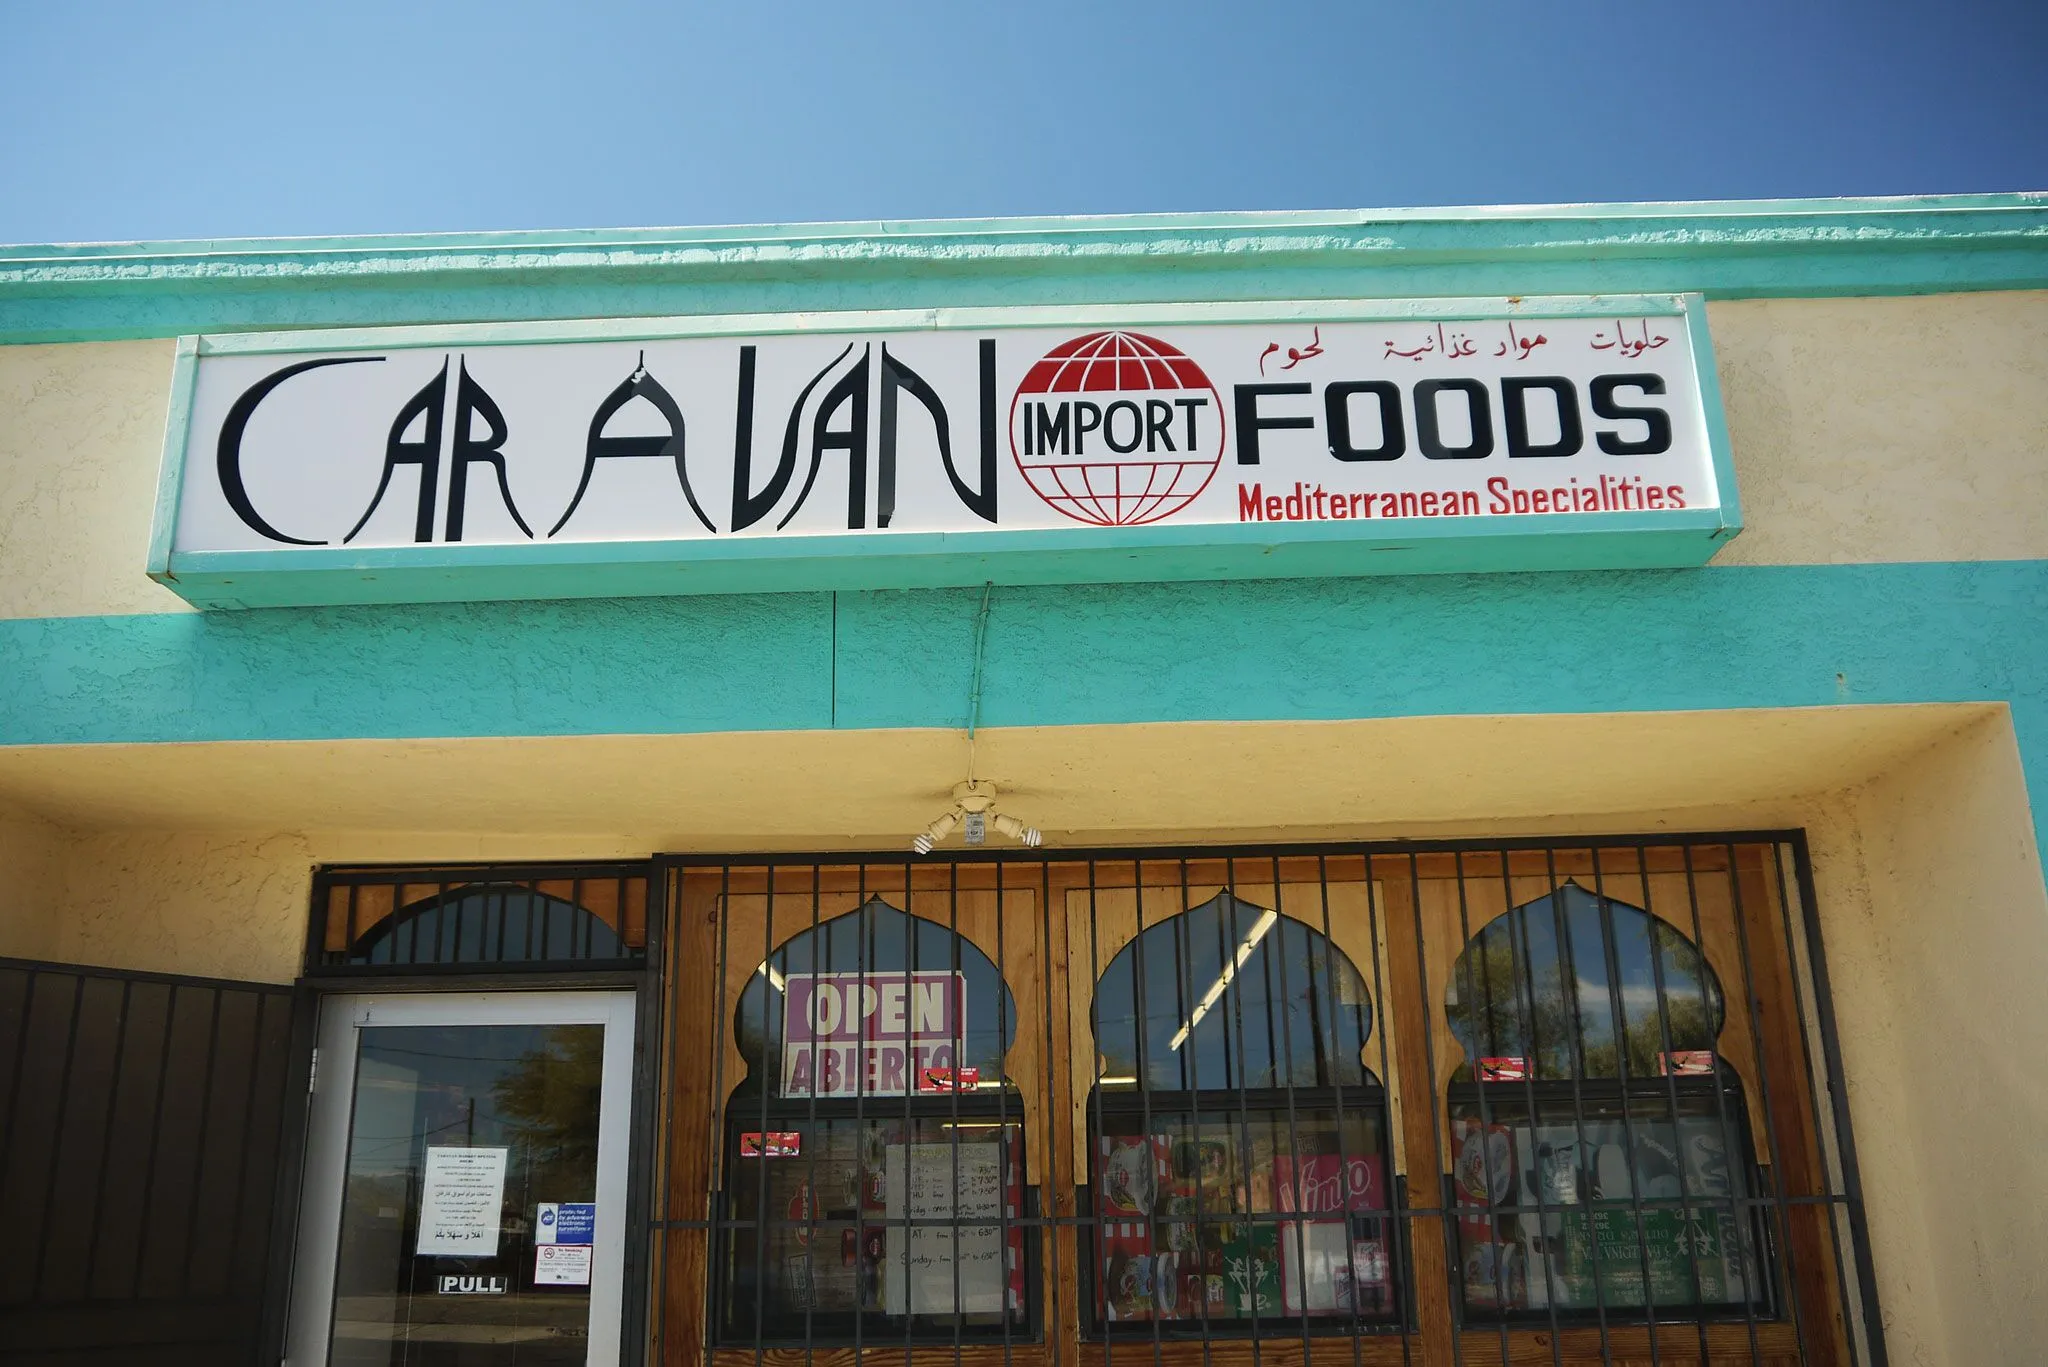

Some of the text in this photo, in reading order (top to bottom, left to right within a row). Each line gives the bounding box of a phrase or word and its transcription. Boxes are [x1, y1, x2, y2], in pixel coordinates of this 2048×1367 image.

[1259, 325, 1324, 377] لحوم
[1590, 318, 1669, 358] حلويات
[217, 339, 1674, 545] CARAVAN IMPORT FOODS
[1238, 474, 1687, 522] Mediterranean Specialities
[806, 982, 944, 1036] OPEN
[444, 1276, 503, 1293] PULL
